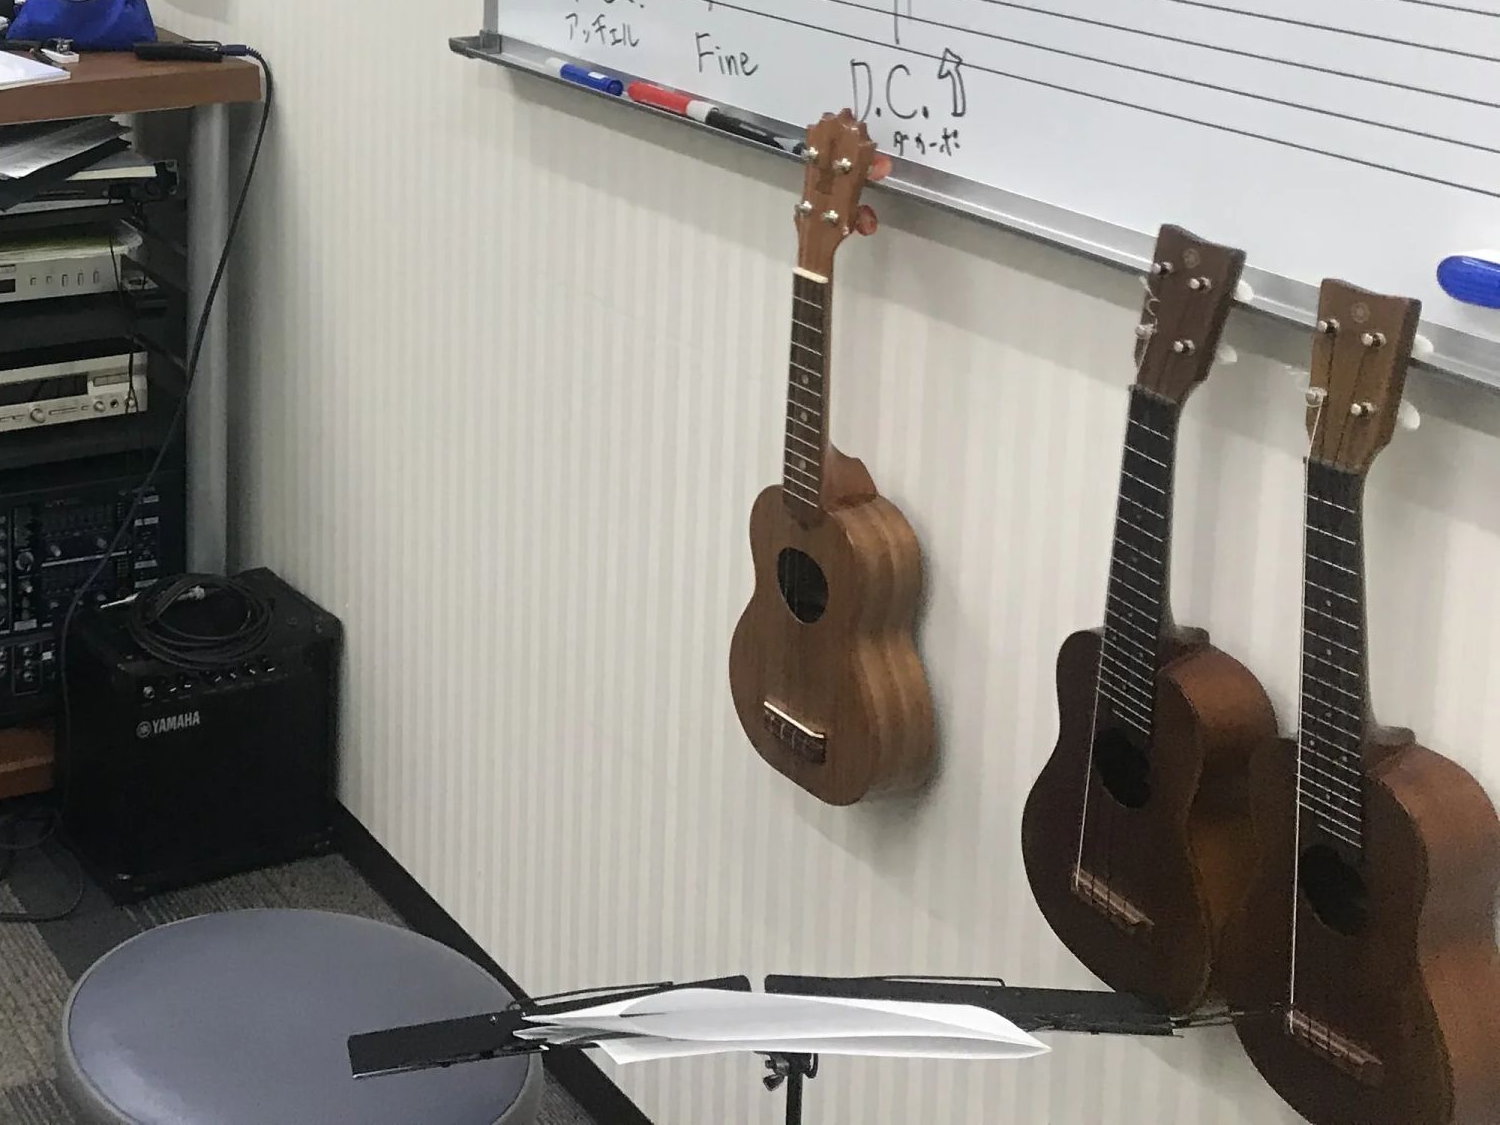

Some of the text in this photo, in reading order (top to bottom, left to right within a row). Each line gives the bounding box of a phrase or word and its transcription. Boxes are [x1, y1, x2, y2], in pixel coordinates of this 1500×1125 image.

[695, 31, 759, 77] Fine
[849, 58, 930, 123] D.C.
[152, 710, 200, 734] YAMAHA
